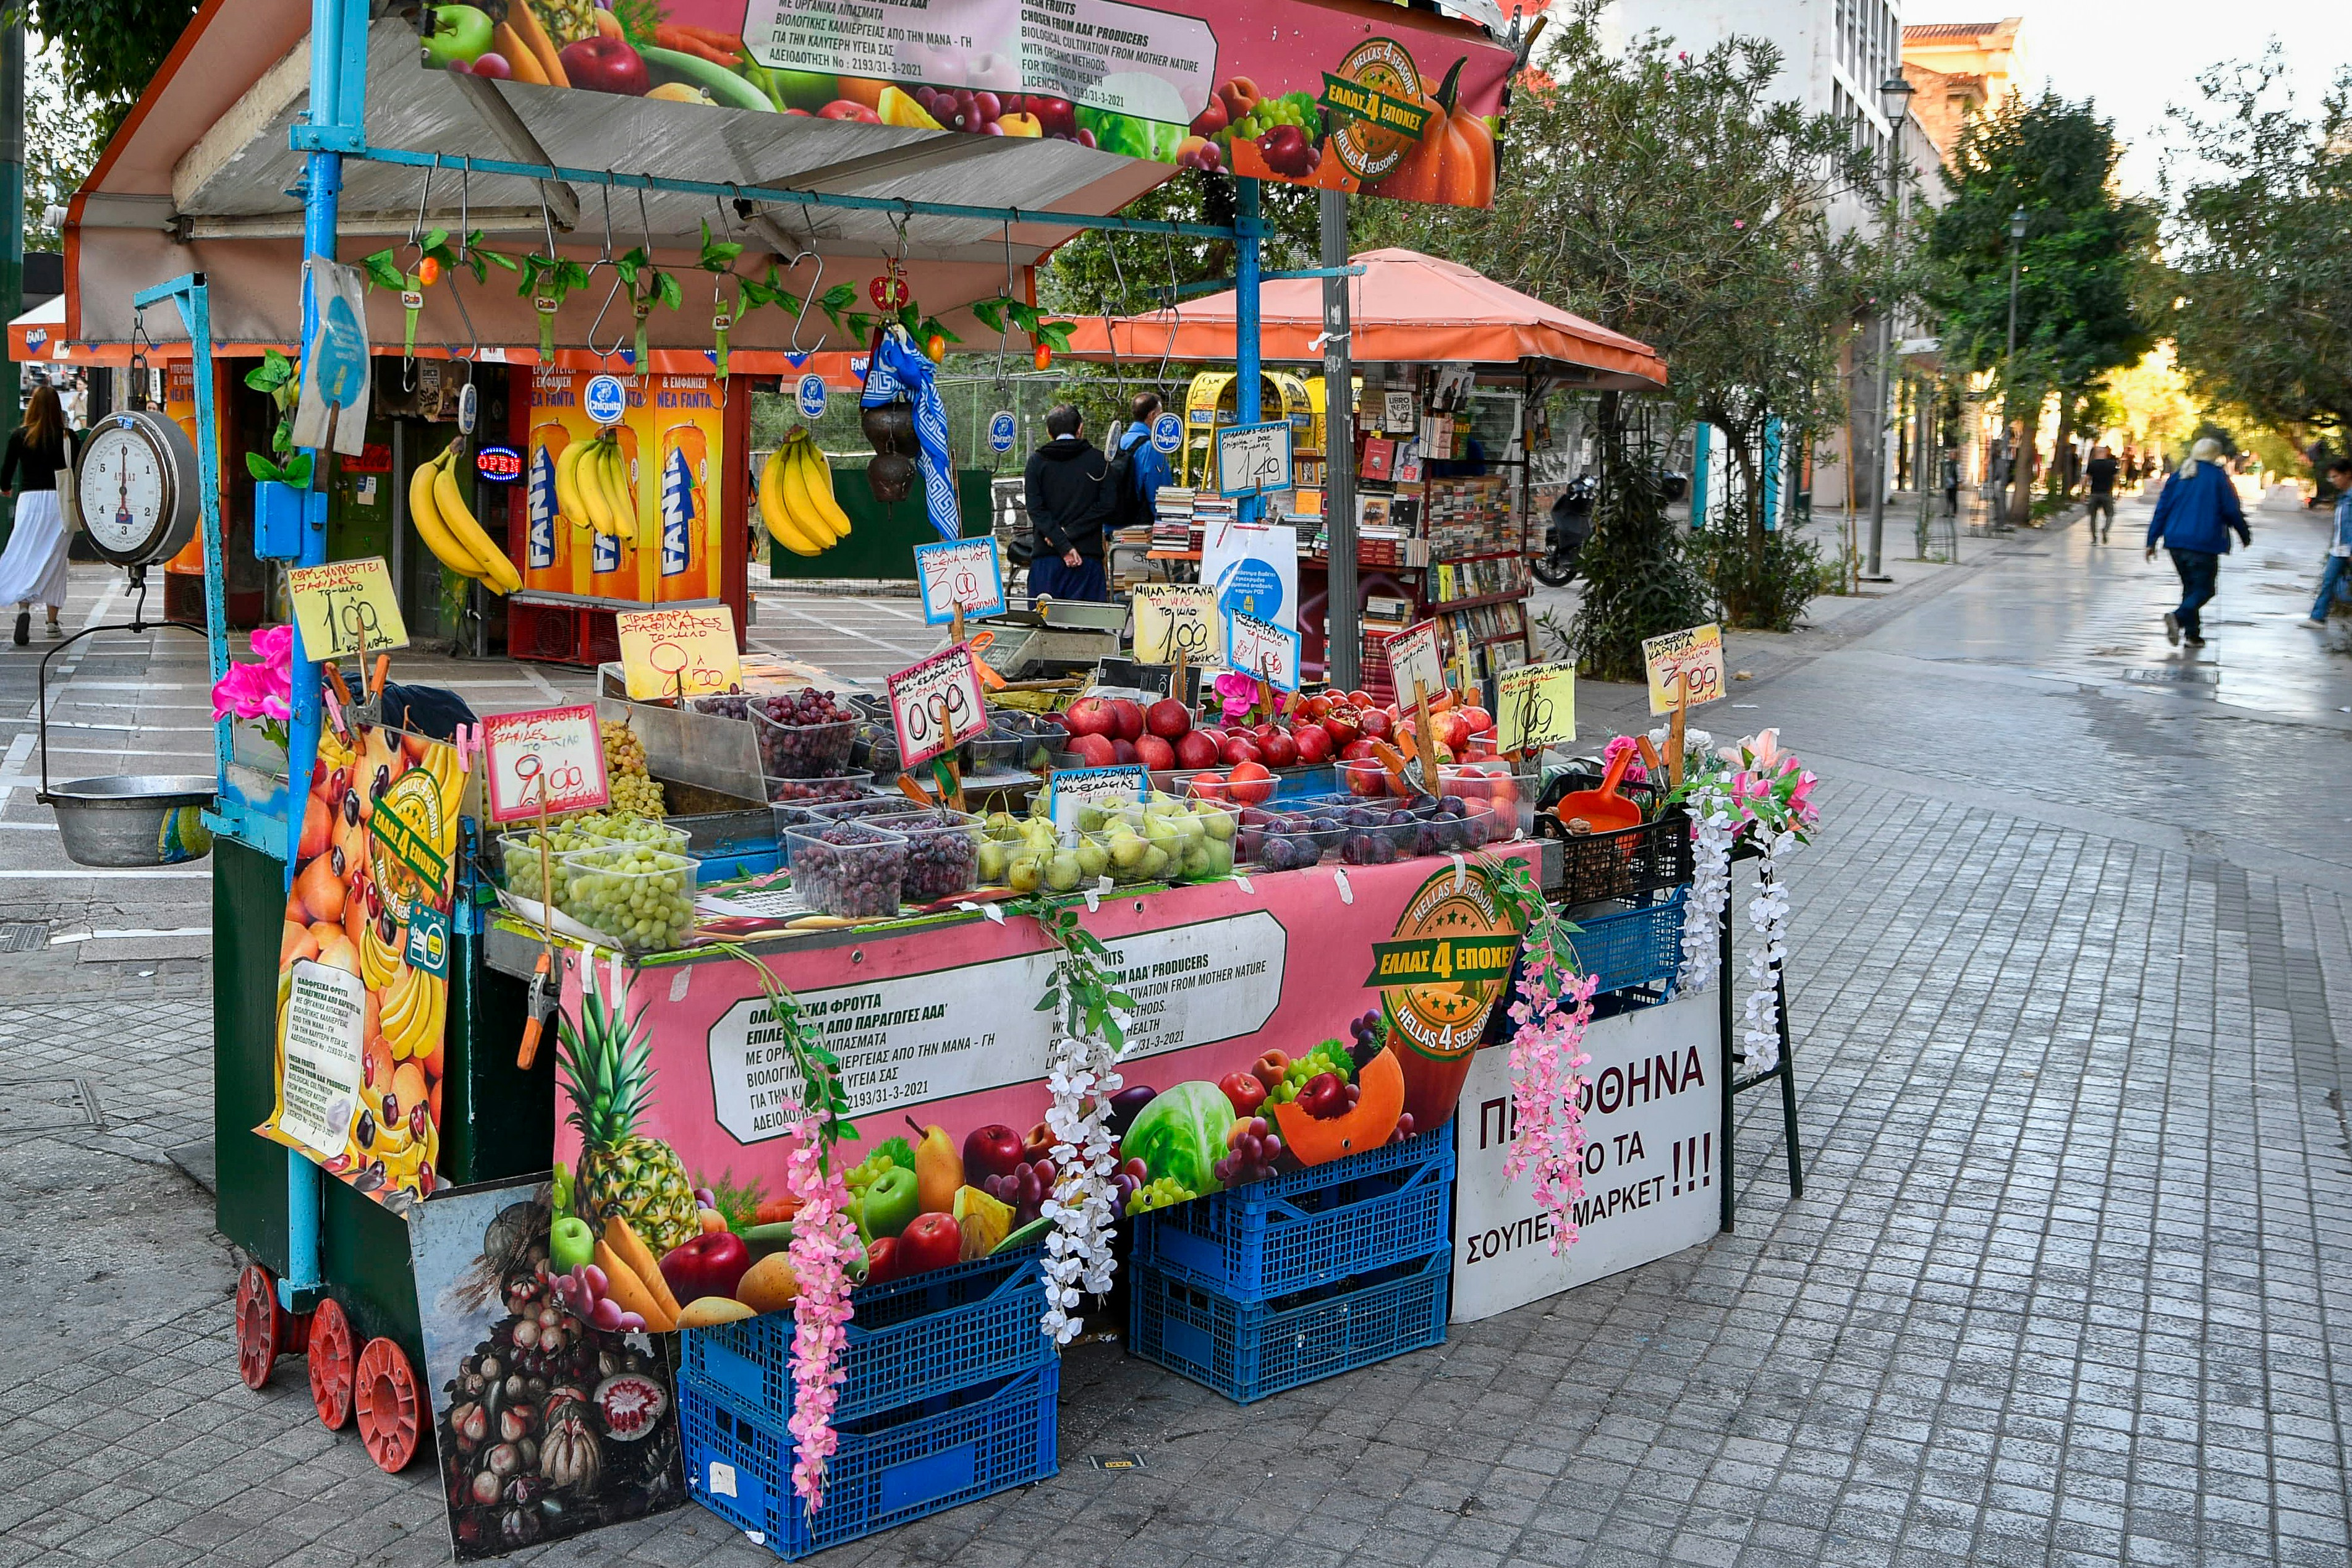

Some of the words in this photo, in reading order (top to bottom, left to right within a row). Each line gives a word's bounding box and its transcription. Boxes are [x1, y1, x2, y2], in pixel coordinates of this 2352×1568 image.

[779, 0, 792, 8] ΜΕ
[795, 0, 834, 14] ΟΡΓΑΝΙΚΑ
[837, 4, 883, 21] ΛΙΠΑΣΜΑΤΑ
[1045, 0, 1076, 15] FRUITS
[775, 13, 826, 30] ΒΙΟΛΟΓΙΚΗΣ
[828, 20, 885, 38] ΚΑΛΛΙΕΡΓΕΙΑΣ
[887, 28, 904, 41] ΑΠΟ
[907, 30, 923, 43] ΤΗΝ
[927, 33, 952, 47] ΜΑΝΑ
[961, 36, 972, 48] ΓΗ
[1021, 9, 1051, 27] CHOSEN
[1051, 17, 1074, 32] FROM
[1097, 27, 1148, 47] PRODUCERS
[772, 31, 786, 43] ΓΙΑ
[789, 32, 805, 46] ΤΗΝ
[807, 35, 850, 51] ΚΑΛΥΤΕΡΗ
[853, 42, 876, 55] ΥΓΕΙΑ
[878, 44, 894, 57] ΣΑΣ
[1021, 43, 1043, 56] WITH
[1045, 46, 1071, 64] ORGANIC
[1072, 53, 1108, 72] METHODS.
[1022, 26, 1061, 46] BIOLOGICAL
[1063, 36, 1110, 57] CULTIVATION
[1111, 46, 1133, 62] FROM
[1136, 51, 1168, 67] MOTHER
[1170, 58, 1199, 73] NATURE
[770, 48, 829, 66] ΑΔΕΙΟΔΟΤΗΣΗ
[852, 58, 922, 77] 2193/31-3-2021
[1022, 59, 1039, 71] FOR
[1041, 61, 1058, 75] YOUR
[1059, 66, 1076, 80] GOOD
[1078, 70, 1103, 87] HEALTH
[1352, 47, 1382, 70] HELLAS
[1383, 41, 1393, 61] 4
[1391, 53, 1416, 95] SEASONS
[1022, 75, 1059, 91] LICENCED
[1073, 86, 1124, 108] 2193/31-3-2021
[1328, 83, 1366, 111] ΕΛΛΑΣ
[1365, 93, 1380, 121] 4
[1381, 103, 1422, 132] ΕΠΟΧΕΣ
[1336, 129, 1357, 166] HELLAS
[1357, 152, 1369, 172] 4
[1366, 149, 1399, 174] SEASONS
[26, 328, 48, 343] FANTA
[663, 377, 668, 388] &
[670, 377, 707, 389] ΕΜΦΑΝΙΣΗ
[589, 400, 621, 413] Chiquita
[680, 391, 711, 409] FANTA
[121, 446, 128, 456] 0
[478, 455, 522, 473] OPEN
[100, 464, 106, 473] 5
[146, 465, 151, 475] 1
[99, 505, 105, 514] 4
[145, 507, 151, 517] 2
[530, 447, 551, 568] FANTA
[662, 450, 685, 575] FANTA
[121, 526, 127, 536] 3
[623, 609, 694, 624] ΠΡΟΣΦΟΡΑ
[397, 779, 422, 799] HELLAS
[420, 775, 432, 793] 4
[425, 790, 439, 839] SEASONS
[373, 811, 399, 843] ΕΛΛΑΣ
[397, 828, 411, 859] 4
[409, 844, 441, 883] ΕΠΟΧΕΣ
[376, 859, 391, 904] HELLAS
[389, 892, 399, 912] 4
[1412, 881, 1451, 923] HELLAS
[1152, 954, 1209, 977] PRODUCERS
[1379, 950, 1430, 975] ΕΛΛΑΣ
[1432, 941, 1452, 979] 4
[1171, 975, 1195, 993] FROM
[1197, 967, 1233, 986] MOTHER
[1236, 960, 1267, 979] NATURE
[831, 993, 881, 1014] ΦΡΟΥΤΑ
[827, 1016, 852, 1035] ΑΠΟ
[855, 1007, 920, 1030] ΠΑΡΑΓΩΓΕΣ
[1126, 1018, 1161, 1037] HEALTH
[1396, 1005, 1437, 1048] HELLAS
[1438, 1023, 1452, 1051] 4
[1454, 1004, 1494, 1049] SEASONS
[745, 1049, 763, 1066] ΜΕ
[825, 1032, 886, 1052] ΛΙΠΑΣΜΑΤΑ
[891, 1045, 914, 1062] ΑΠΟ
[917, 1042, 939, 1059] ΤΗΝ
[941, 1035, 971, 1054] ΜΑΝΑ
[982, 1032, 995, 1047] ΓΗ
[750, 1093, 766, 1109] ΓΙΑ
[768, 1088, 789, 1106] ΤΗΝ
[847, 1072, 877, 1088] ΥΓΕΙΑ
[879, 1067, 898, 1082] ΣΑΣ
[847, 1080, 928, 1109] 2193/31-3-2021
[1613, 1129, 1645, 1167] ΤΑ
[1573, 1174, 1665, 1229] ΜΑΡΚΕΤ
